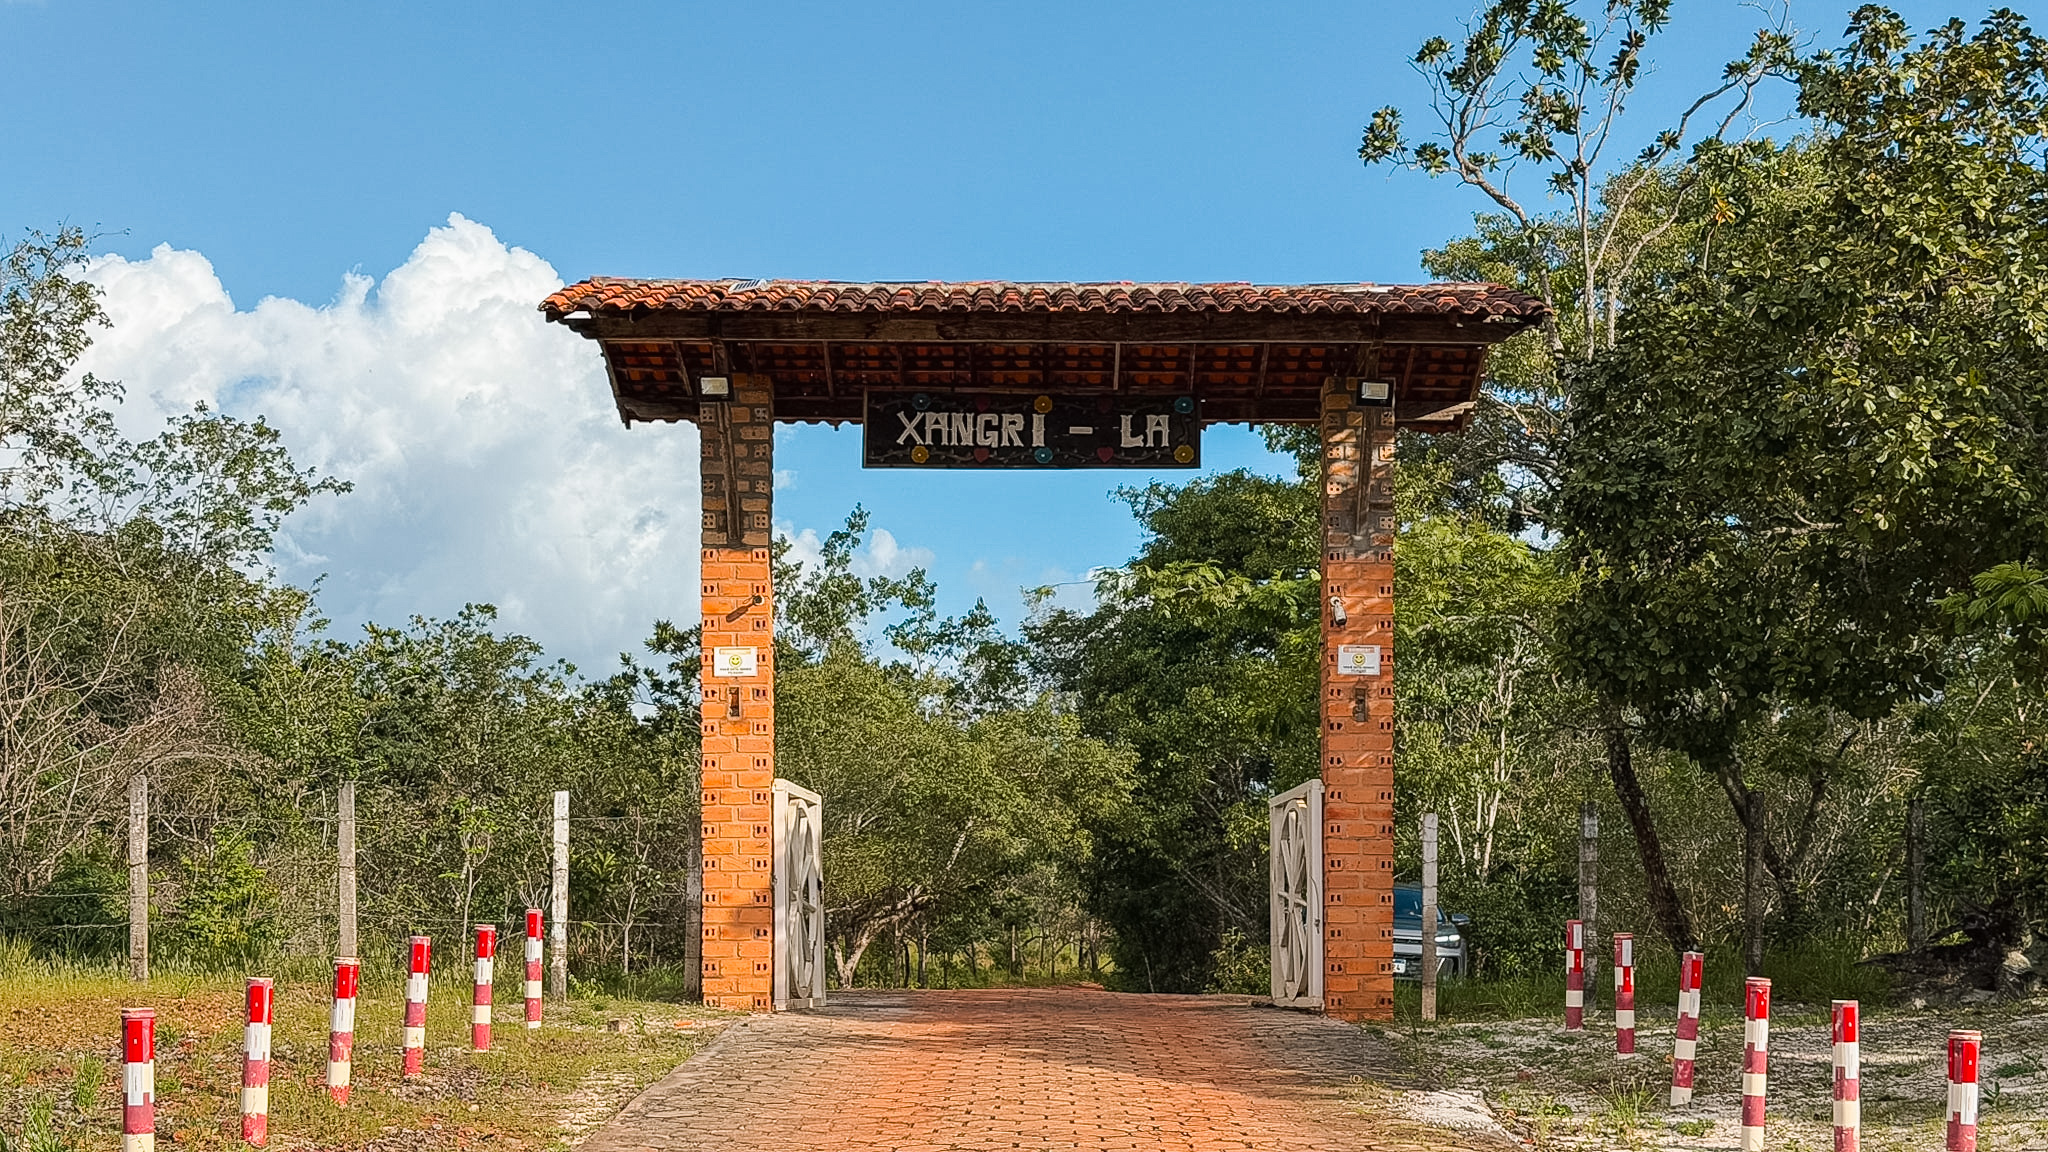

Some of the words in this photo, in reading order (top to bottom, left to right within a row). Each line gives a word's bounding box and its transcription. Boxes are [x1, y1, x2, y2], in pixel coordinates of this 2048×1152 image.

[896, 411, 1046, 448] XANGRI
[1069, 426, 1093, 434] -
[1120, 414, 1170, 448] LA
